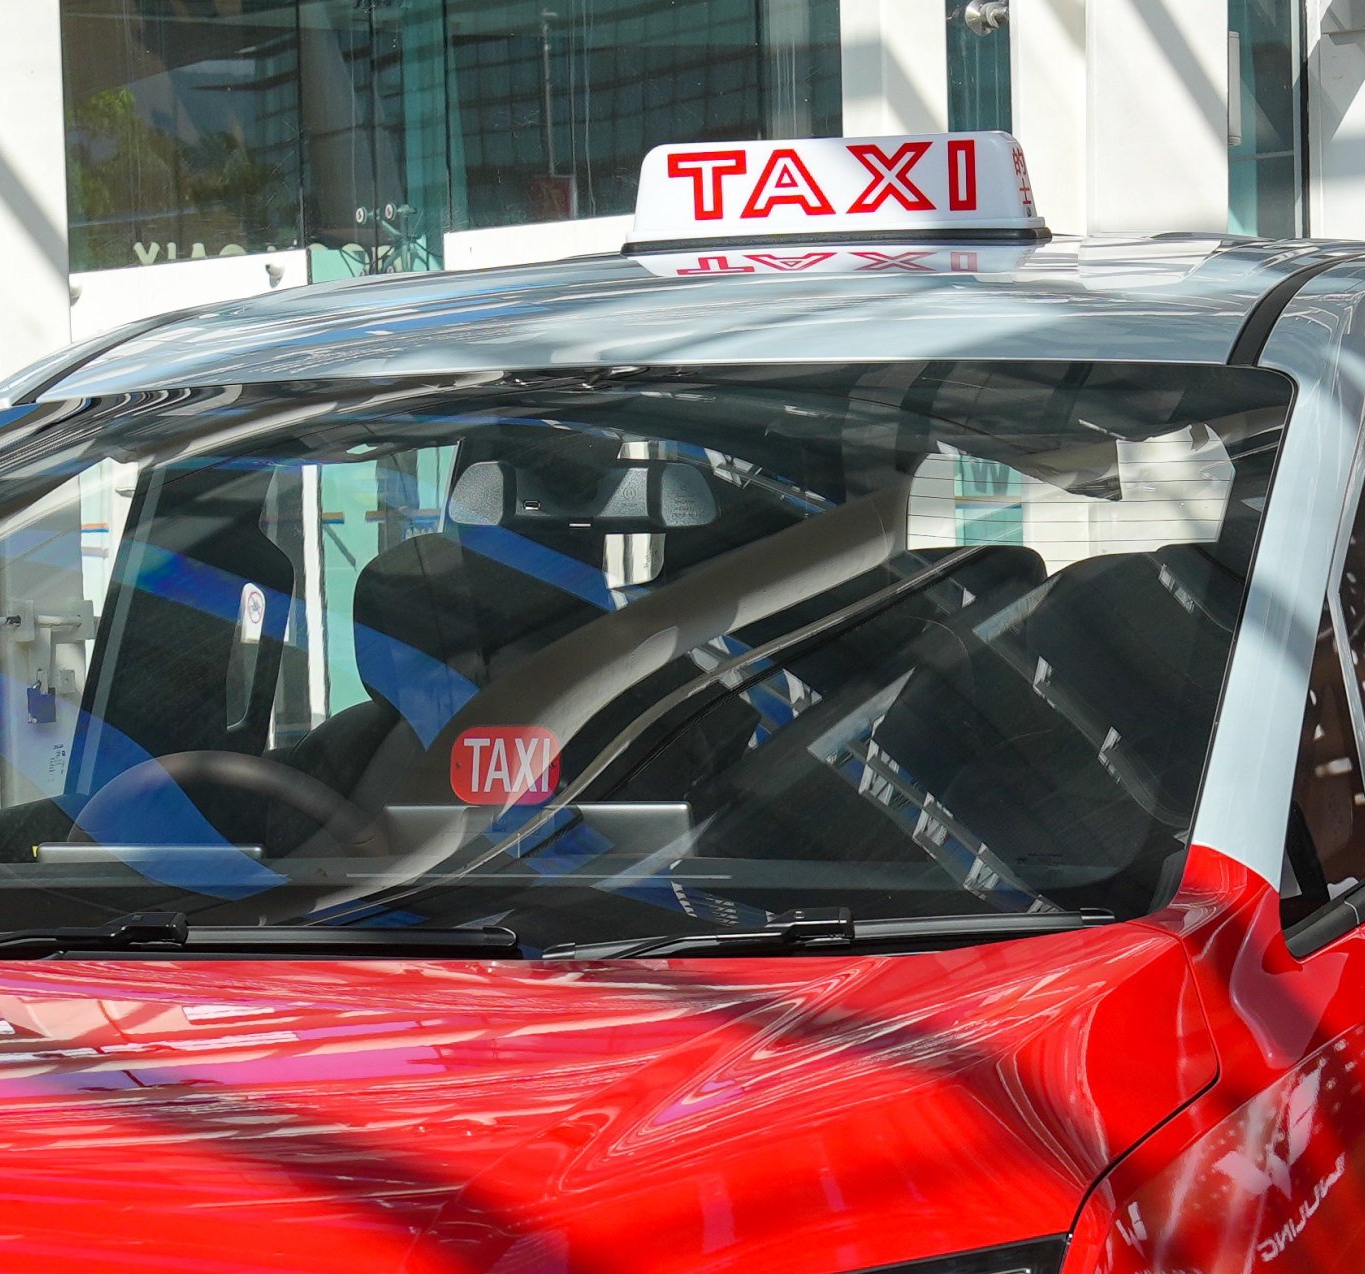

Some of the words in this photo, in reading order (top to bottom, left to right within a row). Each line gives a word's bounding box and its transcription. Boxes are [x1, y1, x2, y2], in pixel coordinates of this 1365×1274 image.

[667, 139, 978, 221] TAXI
[1012, 147, 1032, 205] 的士
[463, 738, 550, 793] TAXI
